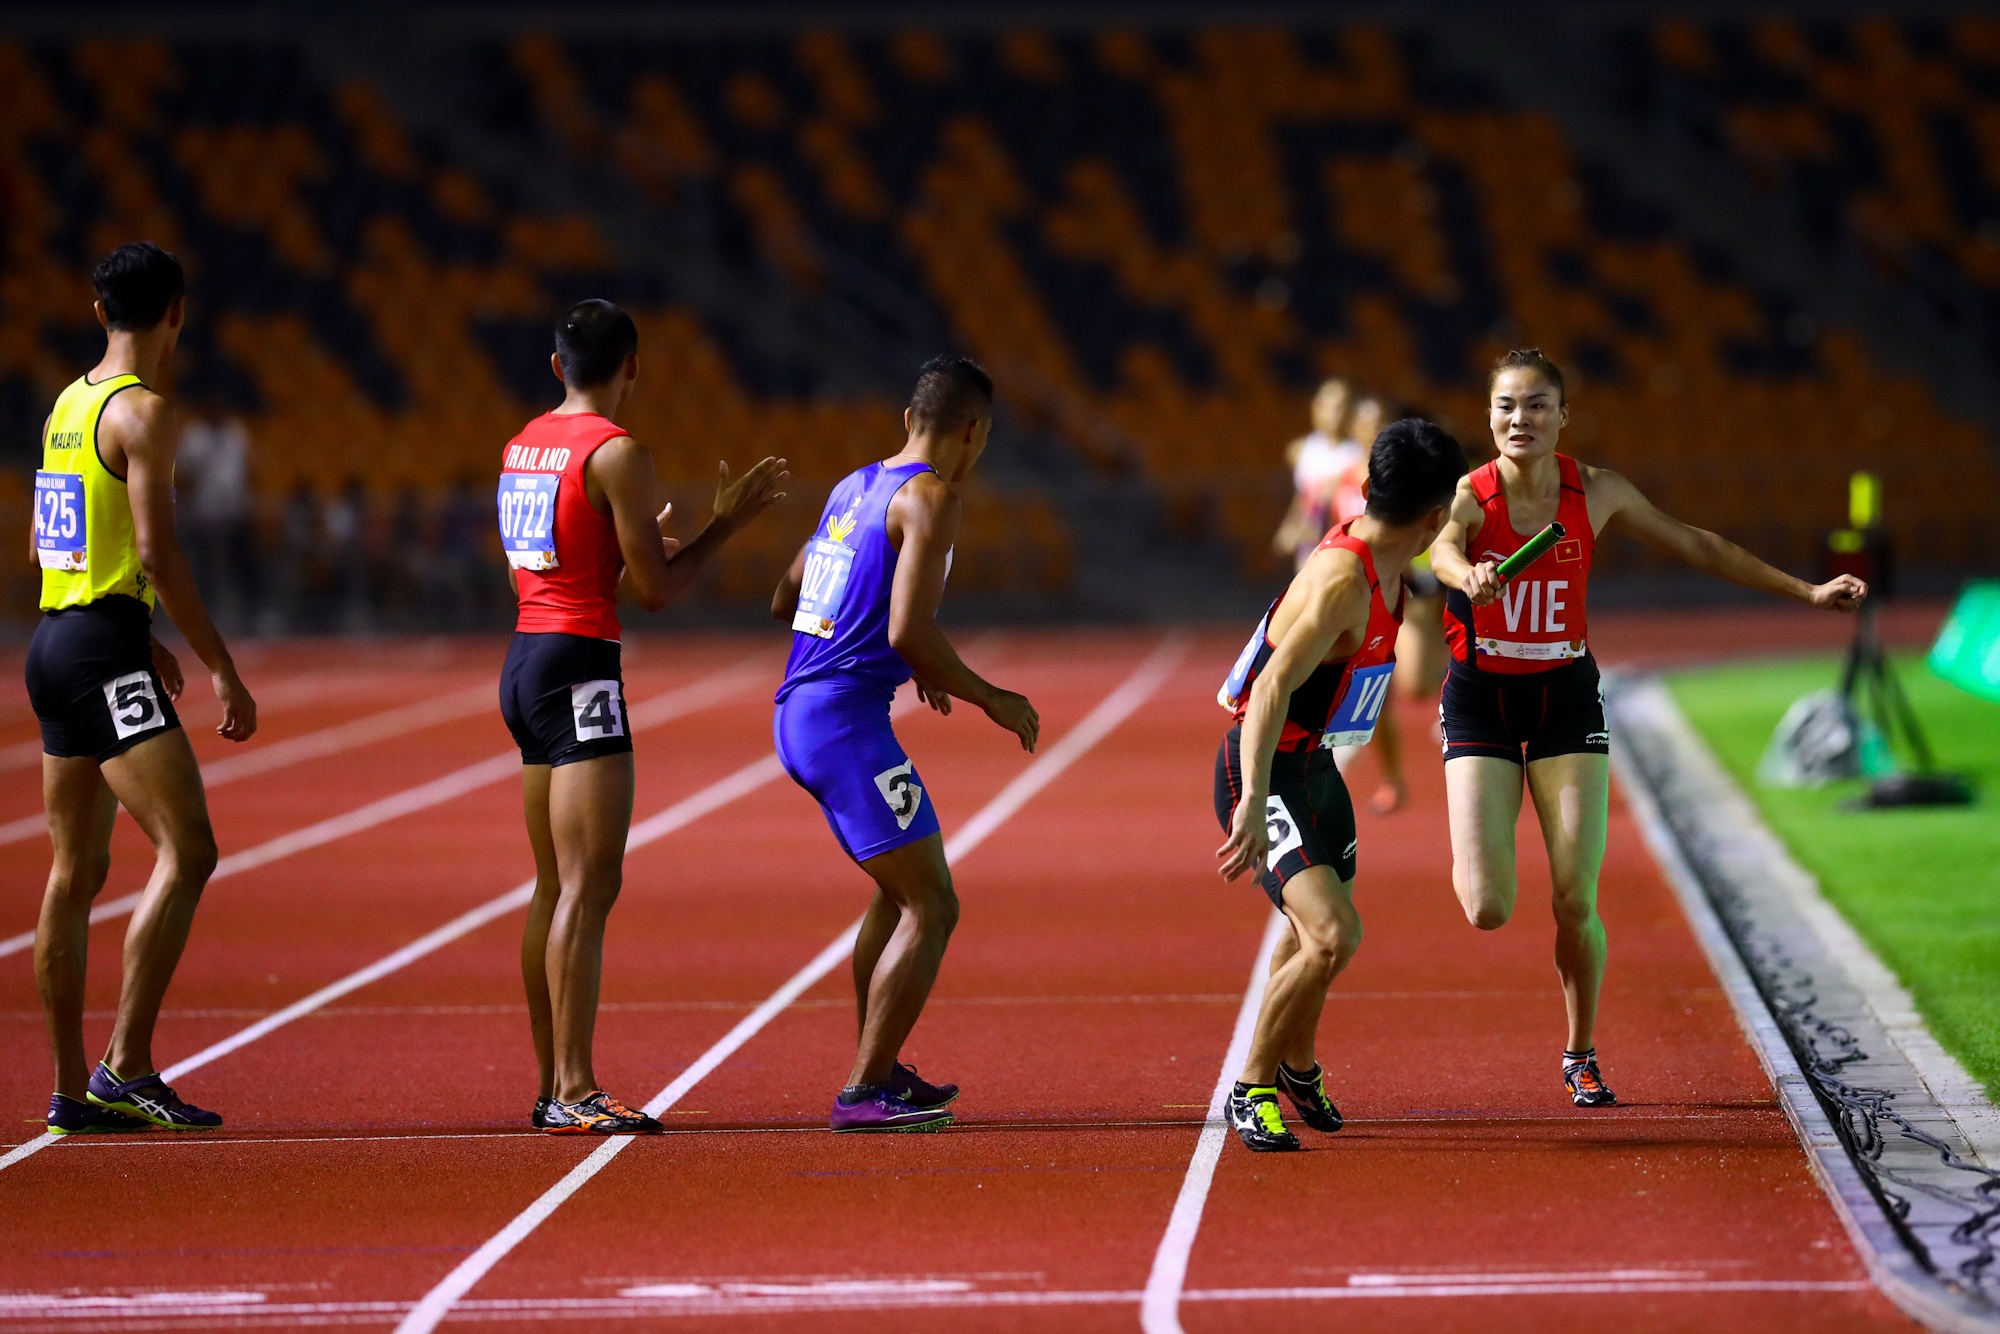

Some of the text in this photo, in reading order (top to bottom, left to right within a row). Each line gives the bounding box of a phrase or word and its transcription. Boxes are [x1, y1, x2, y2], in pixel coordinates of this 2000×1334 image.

[50, 432, 82, 449] MALAYSIA
[504, 445, 571, 471] THAILAND
[34, 490, 77, 539] 425
[501, 491, 548, 538] 0722
[1501, 580, 1569, 633] VIE
[115, 680, 155, 727] 5
[578, 690, 617, 734] 4
[1350, 672, 1392, 723] VI
[889, 773, 912, 817] 3
